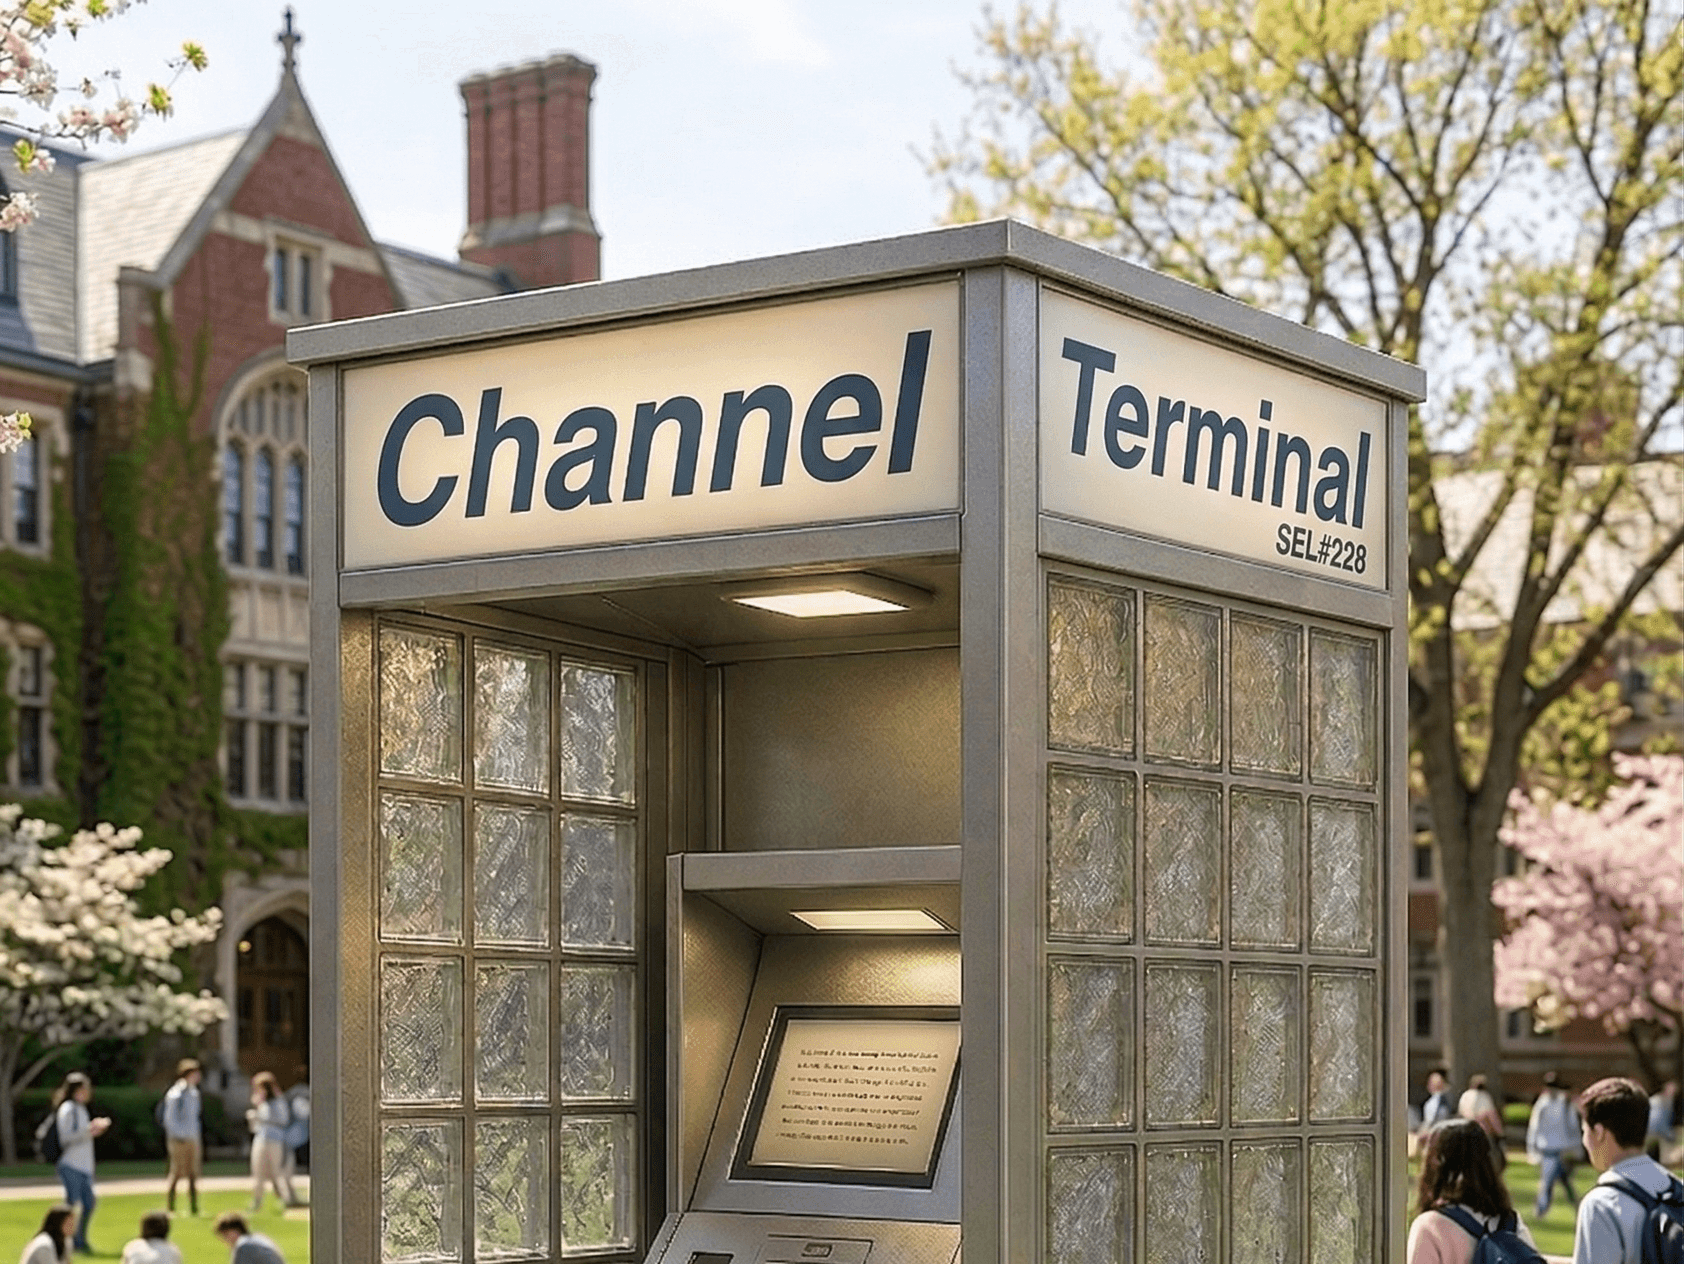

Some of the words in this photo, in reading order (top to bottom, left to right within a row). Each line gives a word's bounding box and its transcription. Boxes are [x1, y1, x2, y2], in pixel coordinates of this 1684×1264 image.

[376, 329, 933, 527] Channel
[1061, 336, 1372, 530] Terminal
[1275, 522, 1368, 575] SEL#228
